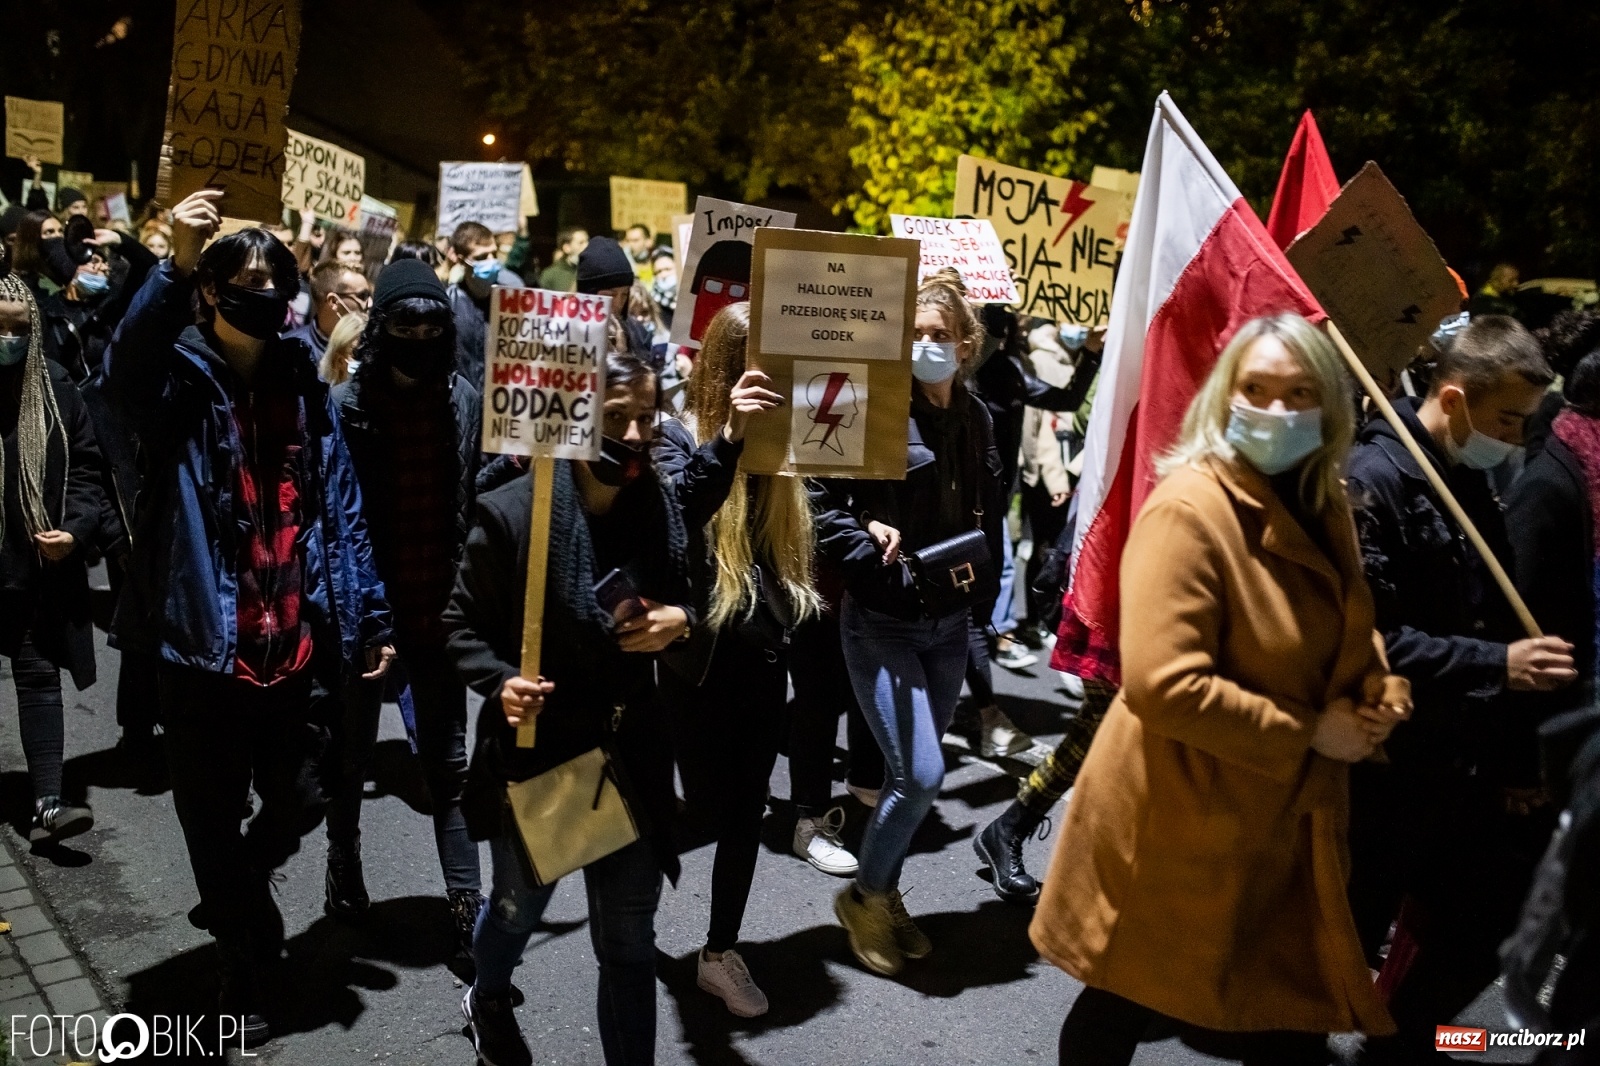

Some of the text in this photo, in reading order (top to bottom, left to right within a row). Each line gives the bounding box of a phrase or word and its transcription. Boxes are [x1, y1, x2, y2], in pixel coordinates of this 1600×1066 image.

[177, 0, 291, 48] ARKA
[174, 41, 286, 90] GDYNIA
[171, 83, 269, 135] KAJA
[168, 132, 286, 183] GODEK
[284, 135, 362, 182] EDRON MA
[974, 165, 1060, 227] MOJA
[703, 210, 773, 237] Impos
[903, 217, 982, 235] GODEK TY
[827, 262, 846, 274] NA
[977, 254, 994, 265] MI
[1002, 225, 1115, 281] SIA NIE
[797, 282, 873, 298] HALLOWEEN
[500, 289, 607, 323] WOLNOŚĆ
[780, 304, 887, 322] PRZEBIORĘ SIĘ ZA
[498, 315, 590, 343] KOCHAM I
[811, 328, 854, 342] GODEK
[495, 338, 598, 368] ROZUMIEM
[491, 362, 598, 393] WOLNOŚCI
[491, 386, 593, 422] ODDAĆ
[490, 418, 596, 447] NIE UMIEM
